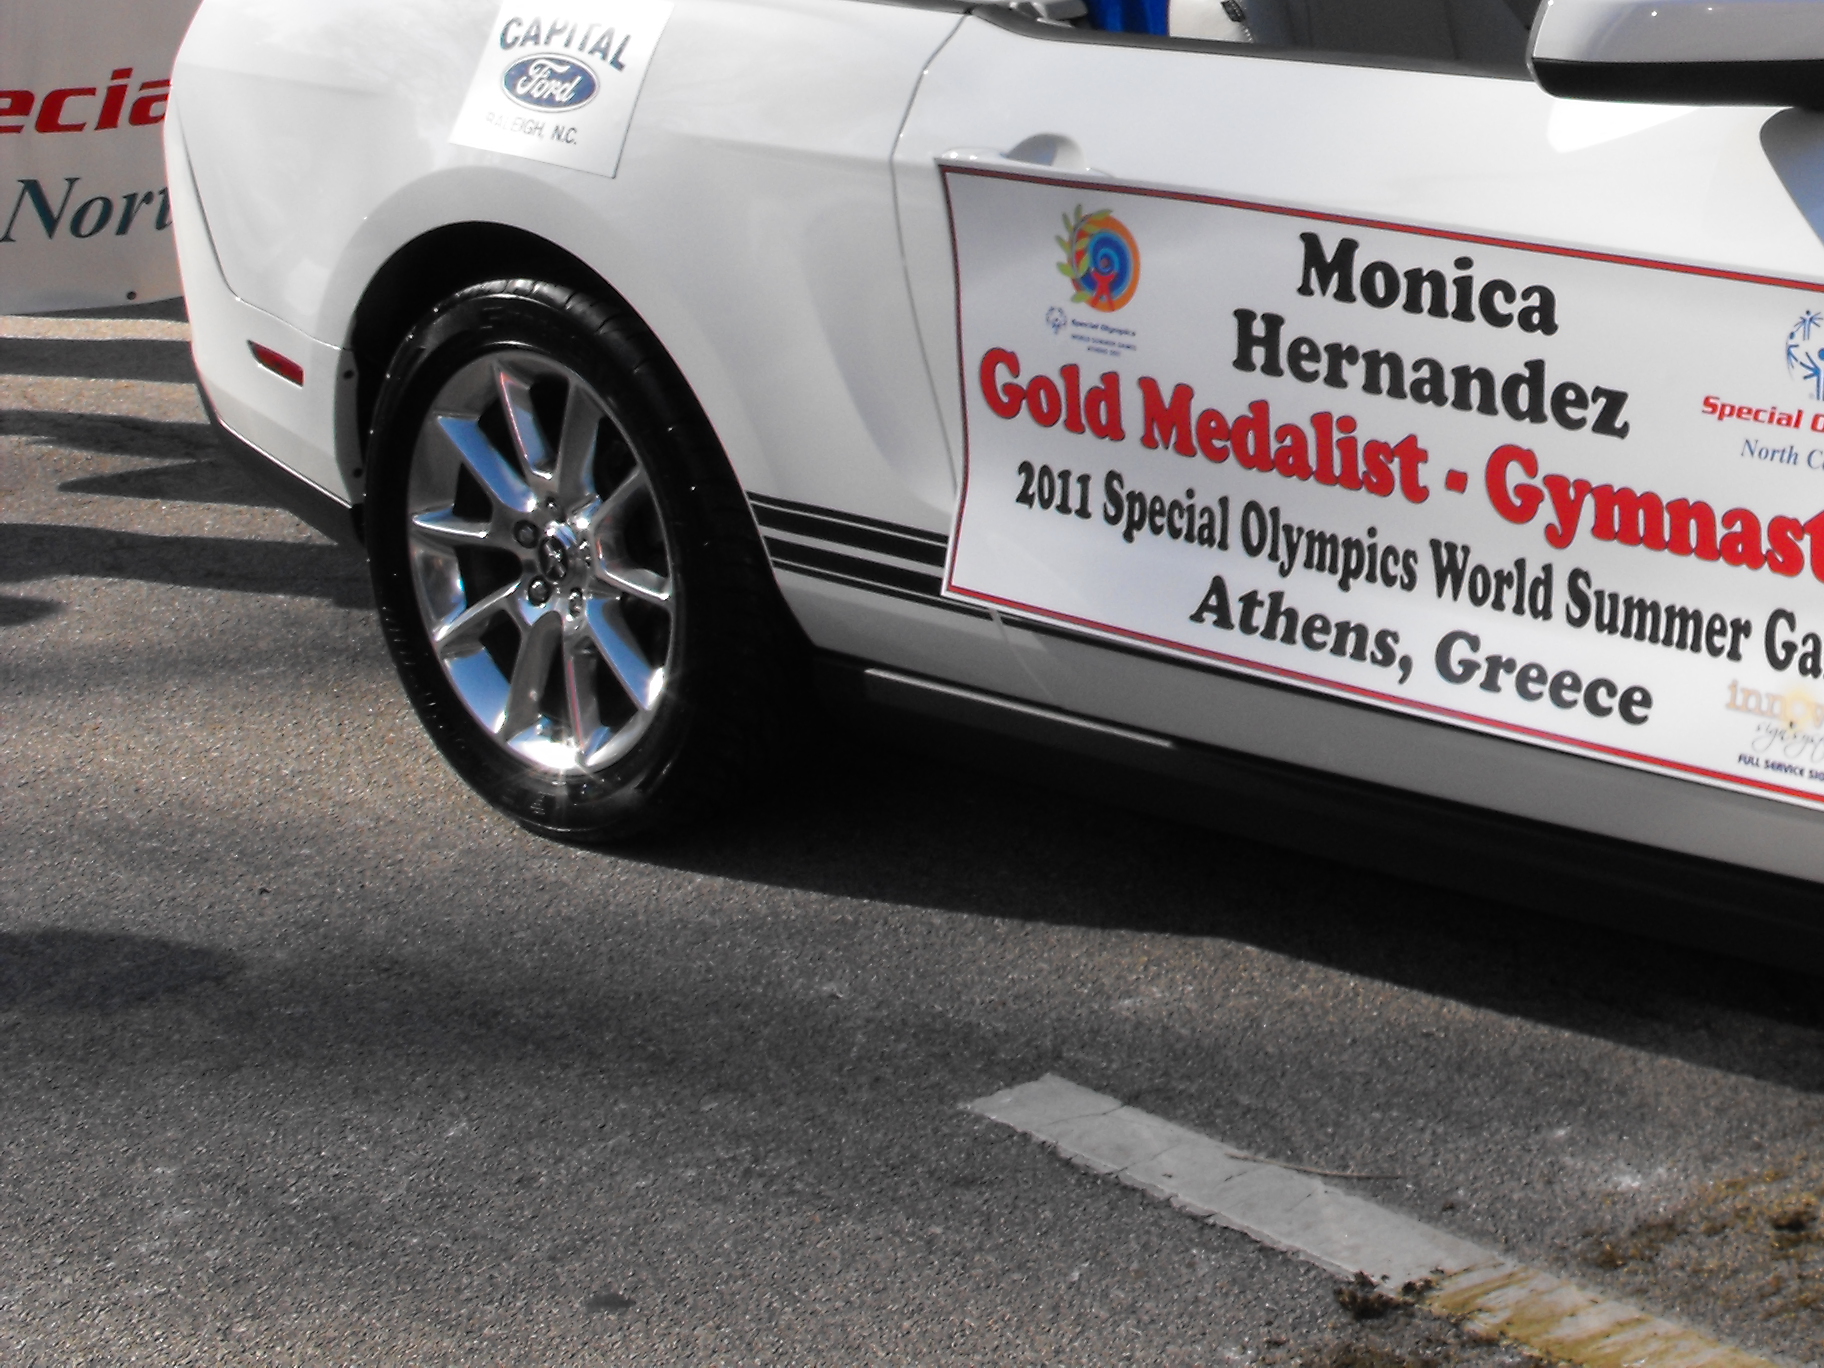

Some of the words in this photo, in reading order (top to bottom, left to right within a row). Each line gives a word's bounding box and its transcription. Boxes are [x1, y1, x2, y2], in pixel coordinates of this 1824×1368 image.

[500, 16, 631, 72] CAPITAL
[517, 57, 583, 103] Ford
[551, 124, 578, 145] N.C.
[1296, 232, 1560, 336] Monica
[1232, 308, 1630, 440] Hernandez
[980, 347, 1125, 441] Gold
[1138, 376, 1430, 505] Medalist
[1701, 394, 1804, 429] Special
[1740, 438, 1799, 466] North
[1015, 461, 1093, 520] 2011
[1103, 469, 1230, 551] Special
[1240, 500, 1419, 592] Olympics
[1429, 537, 1555, 622] World
[1565, 567, 1753, 664] Summer
[1189, 575, 1413, 685] Athens,
[1434, 629, 1654, 726] Greece
[1738, 753, 1760, 769] FULL
[1764, 758, 1805, 777] SERVICE
